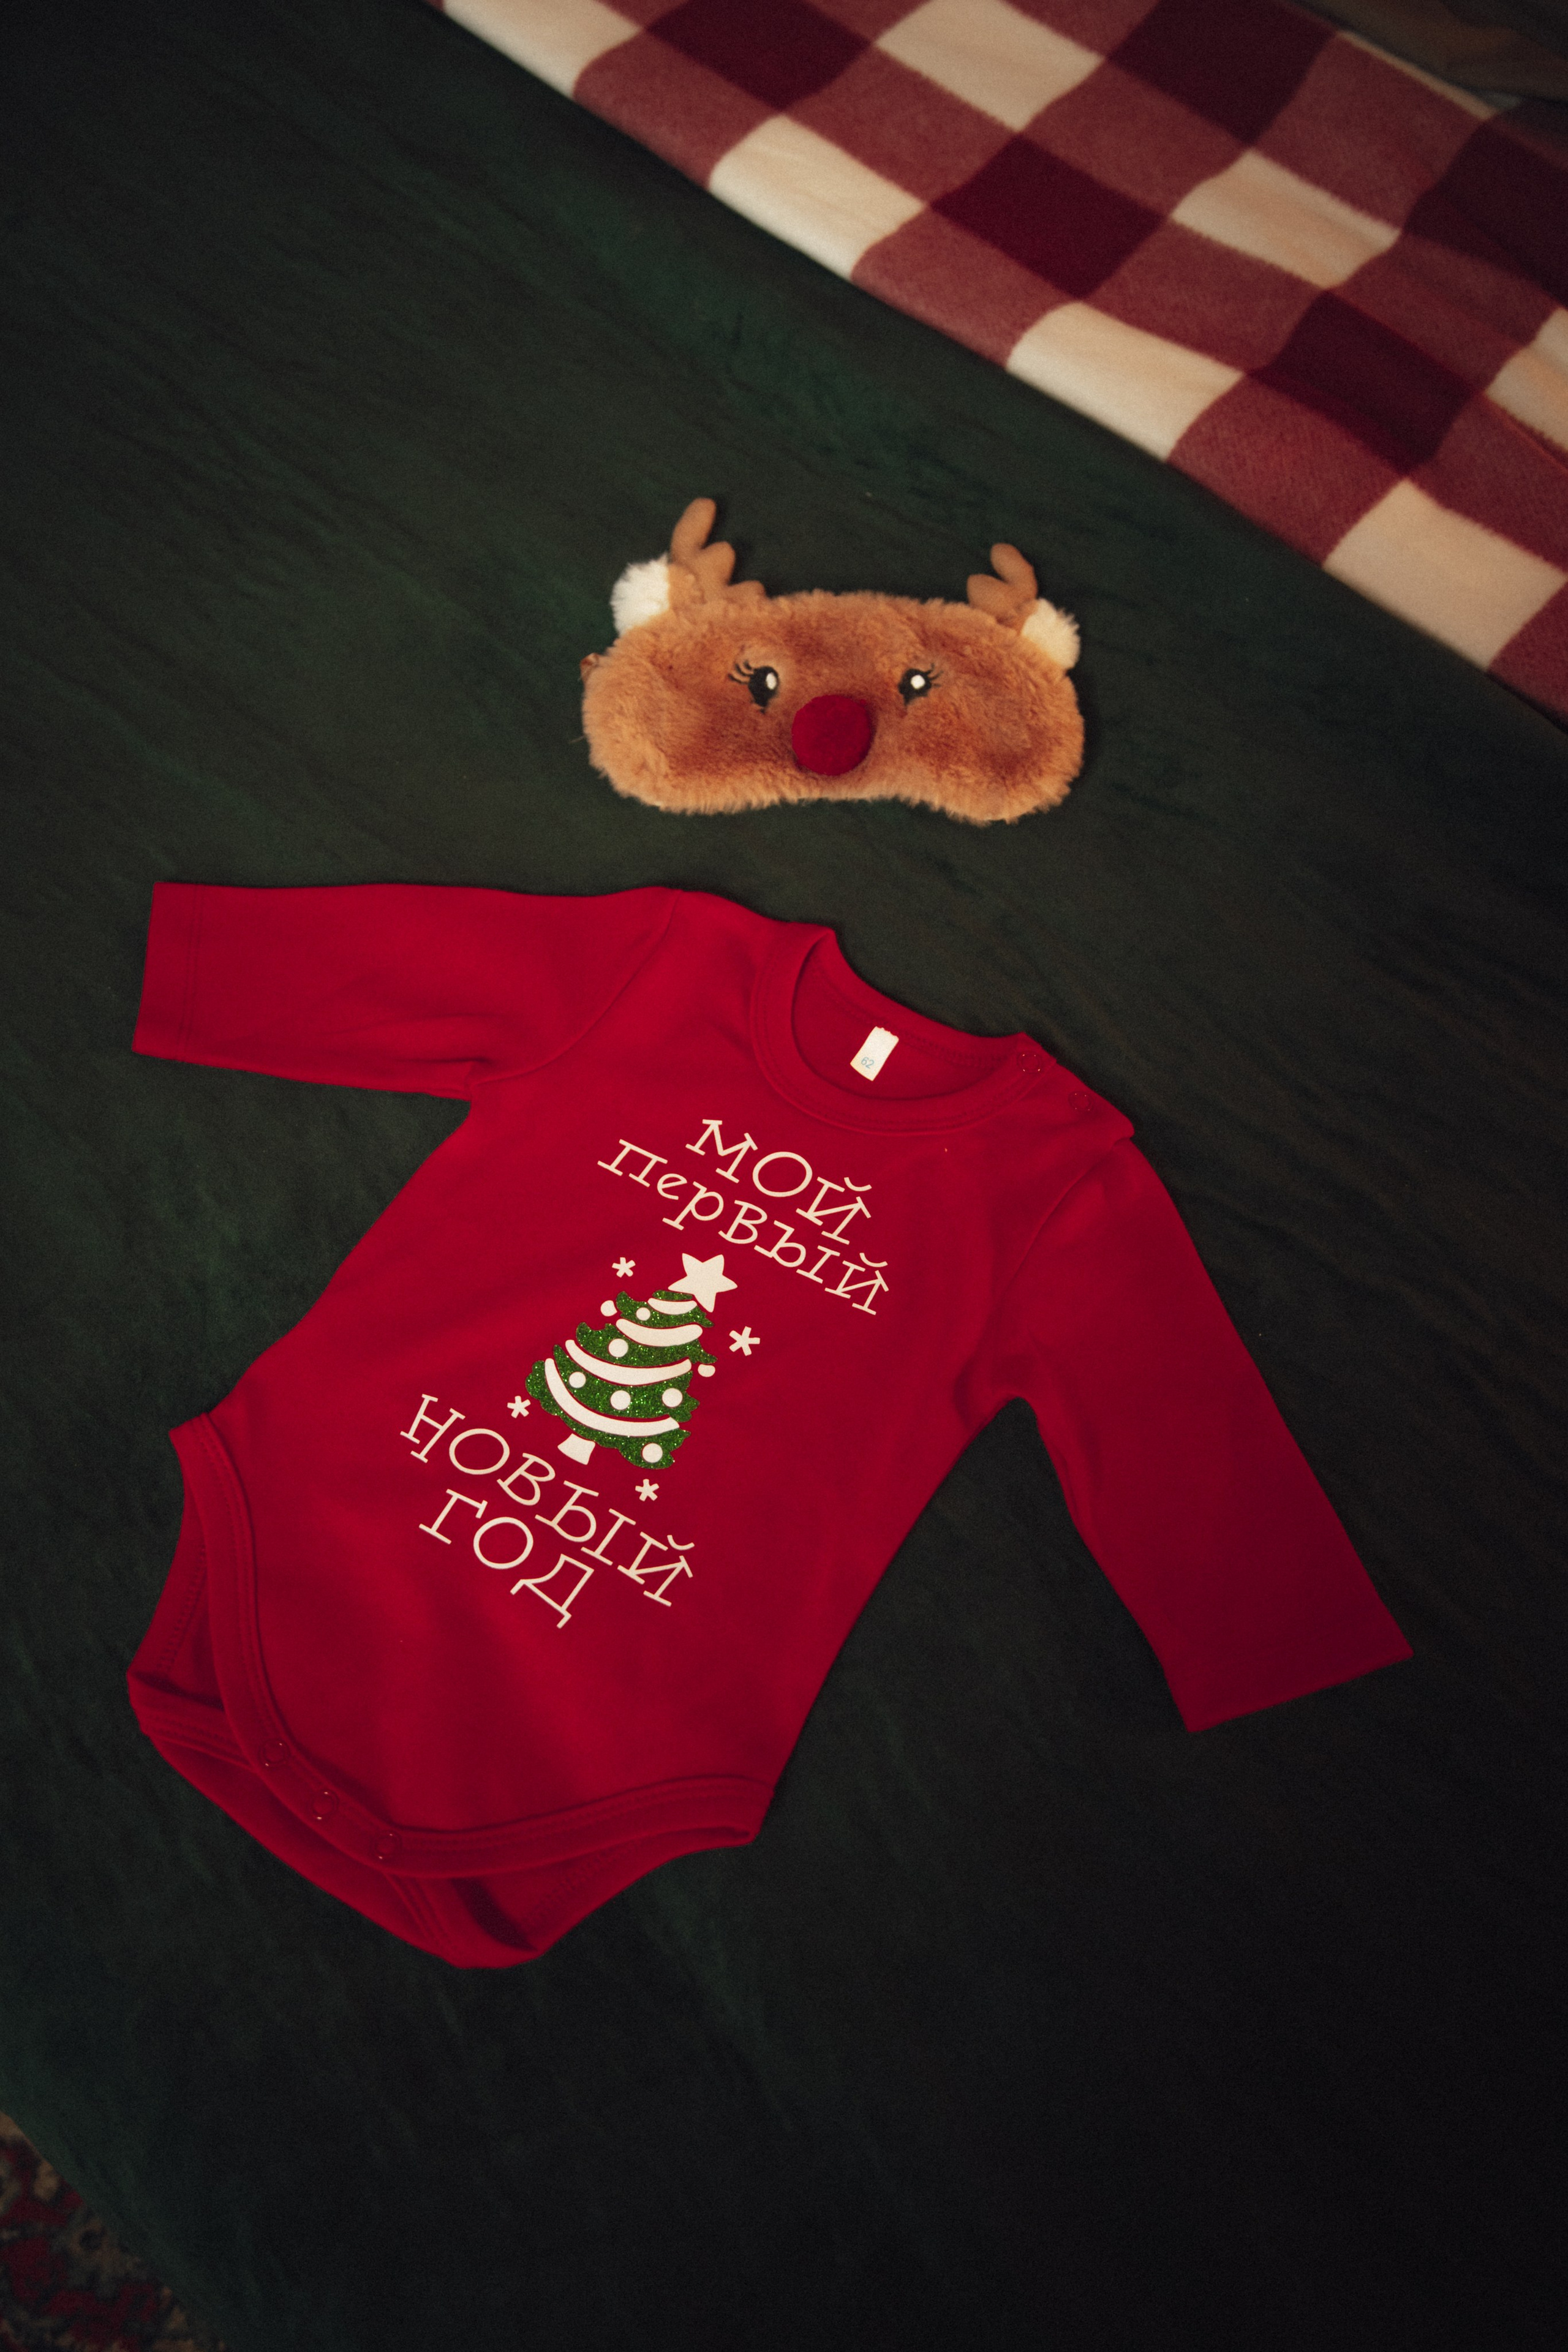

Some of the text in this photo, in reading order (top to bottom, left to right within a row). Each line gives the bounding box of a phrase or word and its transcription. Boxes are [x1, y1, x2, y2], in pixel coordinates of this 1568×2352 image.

[861, 1057, 875, 1069] 62
[685, 1118, 872, 1245] МОЙ
[400, 1393, 695, 1607] НОВЫЙ
[419, 1489, 595, 1629] ГОД
